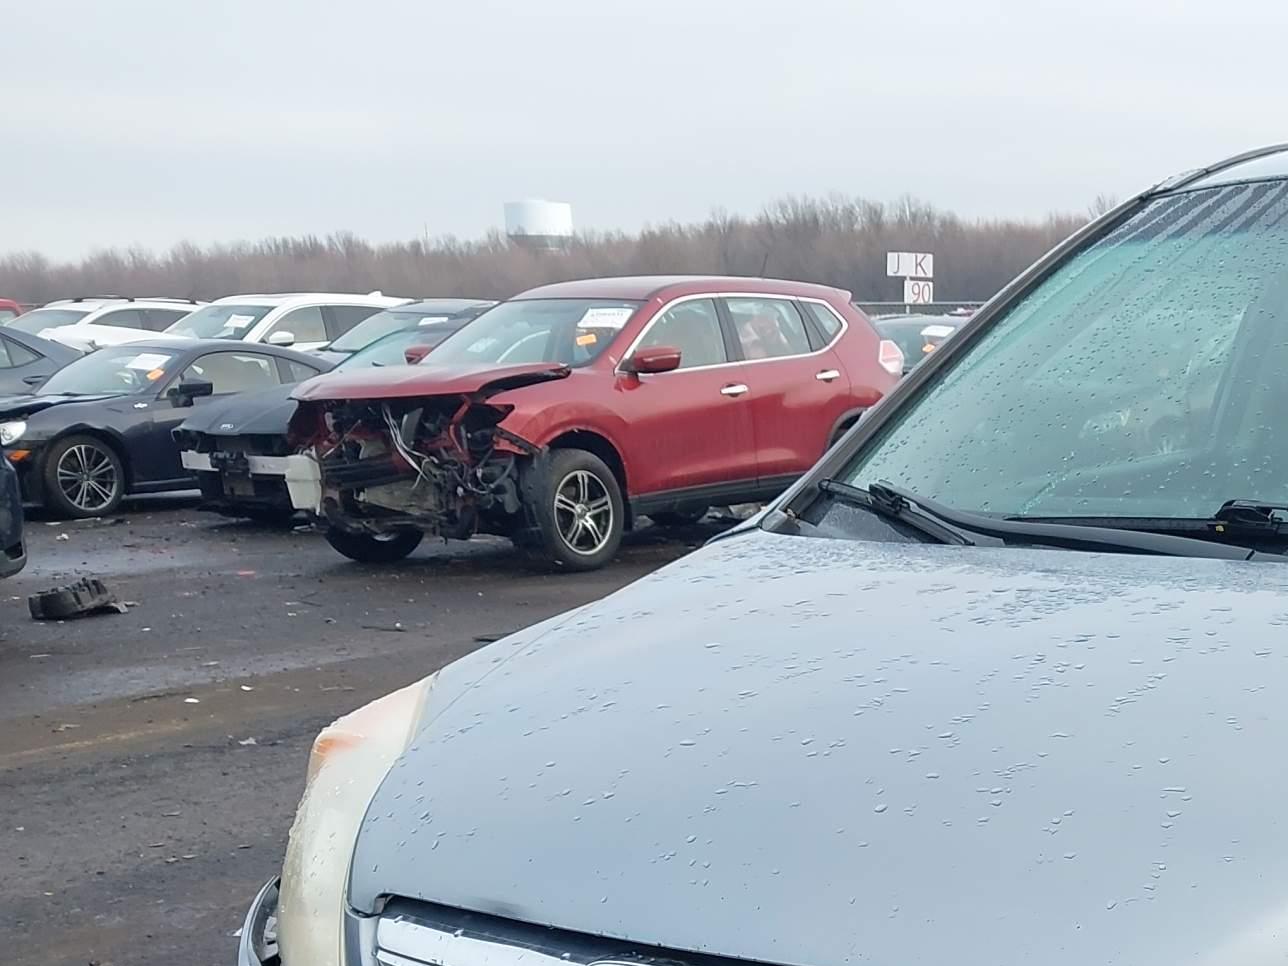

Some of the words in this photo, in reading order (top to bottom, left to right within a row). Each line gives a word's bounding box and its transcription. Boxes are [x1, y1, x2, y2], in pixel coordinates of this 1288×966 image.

[892, 253, 900, 274] J
[914, 254, 928, 276] K
[911, 282, 931, 303] 90
